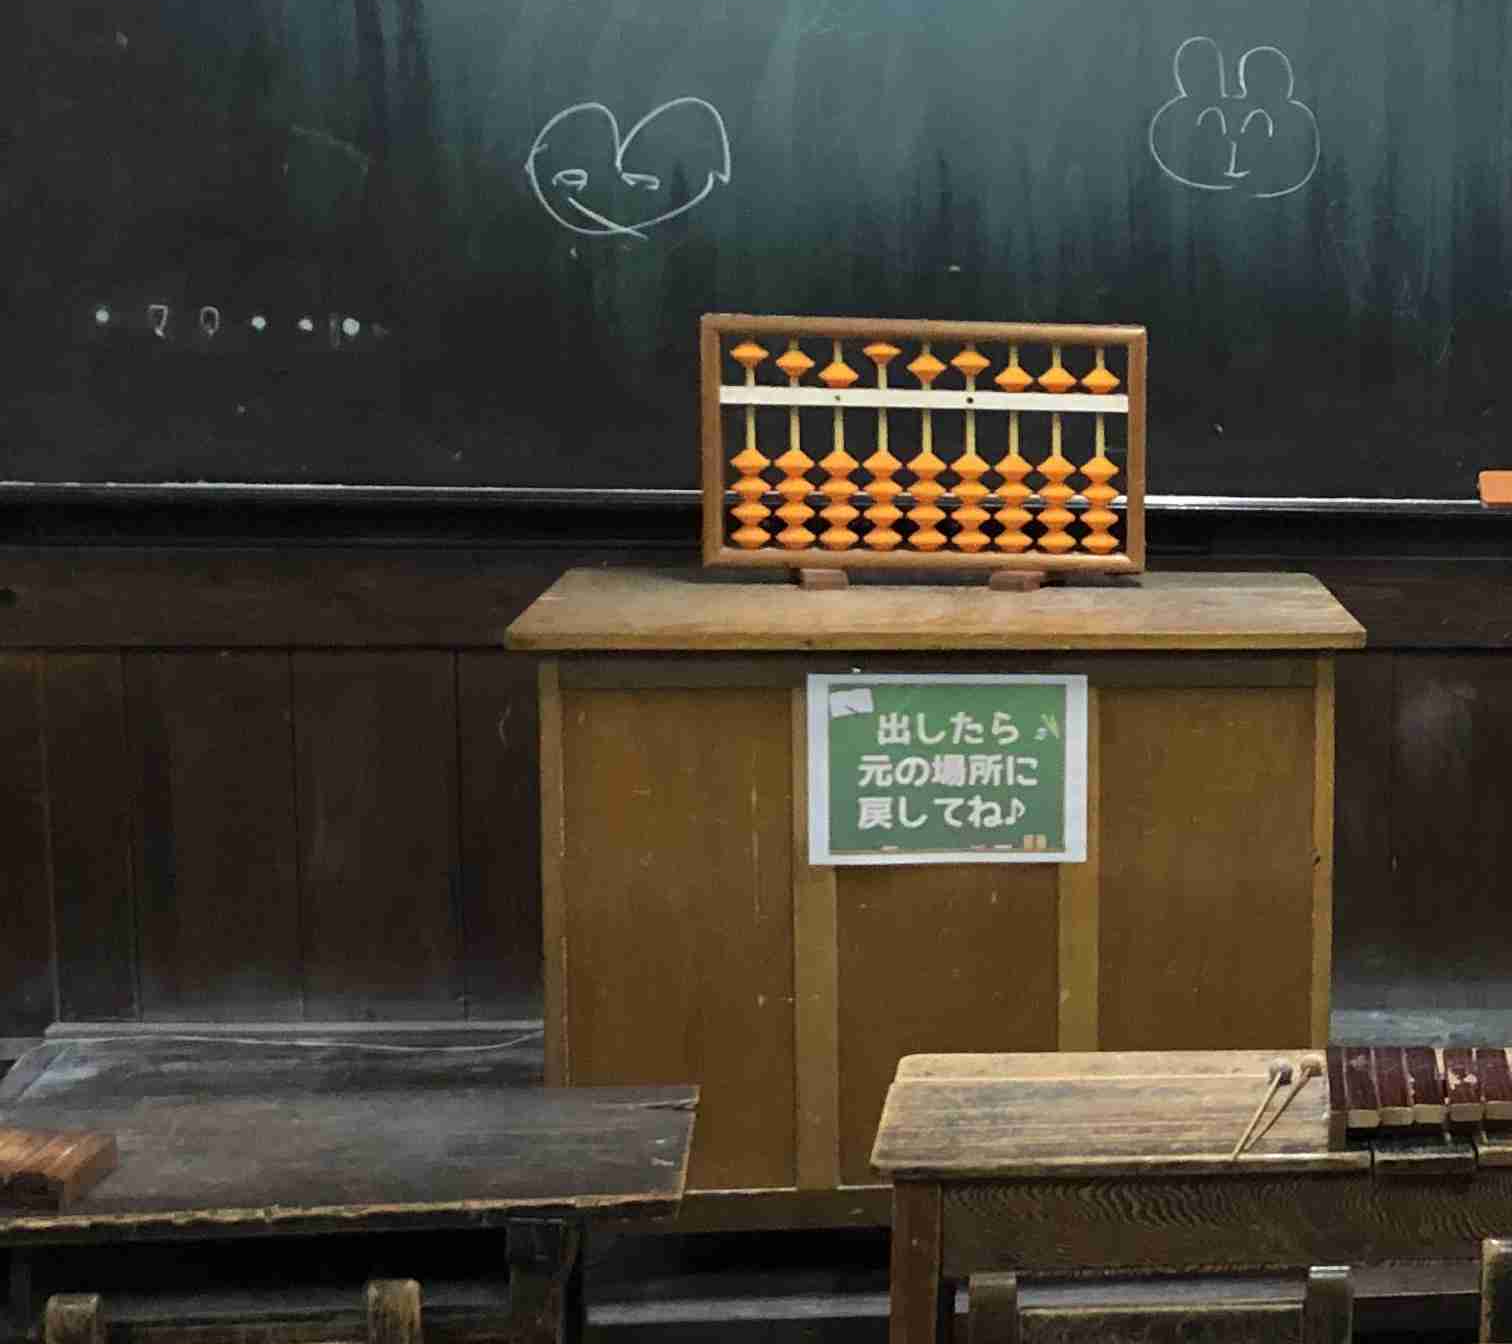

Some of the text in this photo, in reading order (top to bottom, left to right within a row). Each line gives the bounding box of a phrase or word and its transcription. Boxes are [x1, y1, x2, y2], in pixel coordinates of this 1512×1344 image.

[876, 711, 1020, 745] 出したら
[857, 754, 1039, 787] 元の場所に
